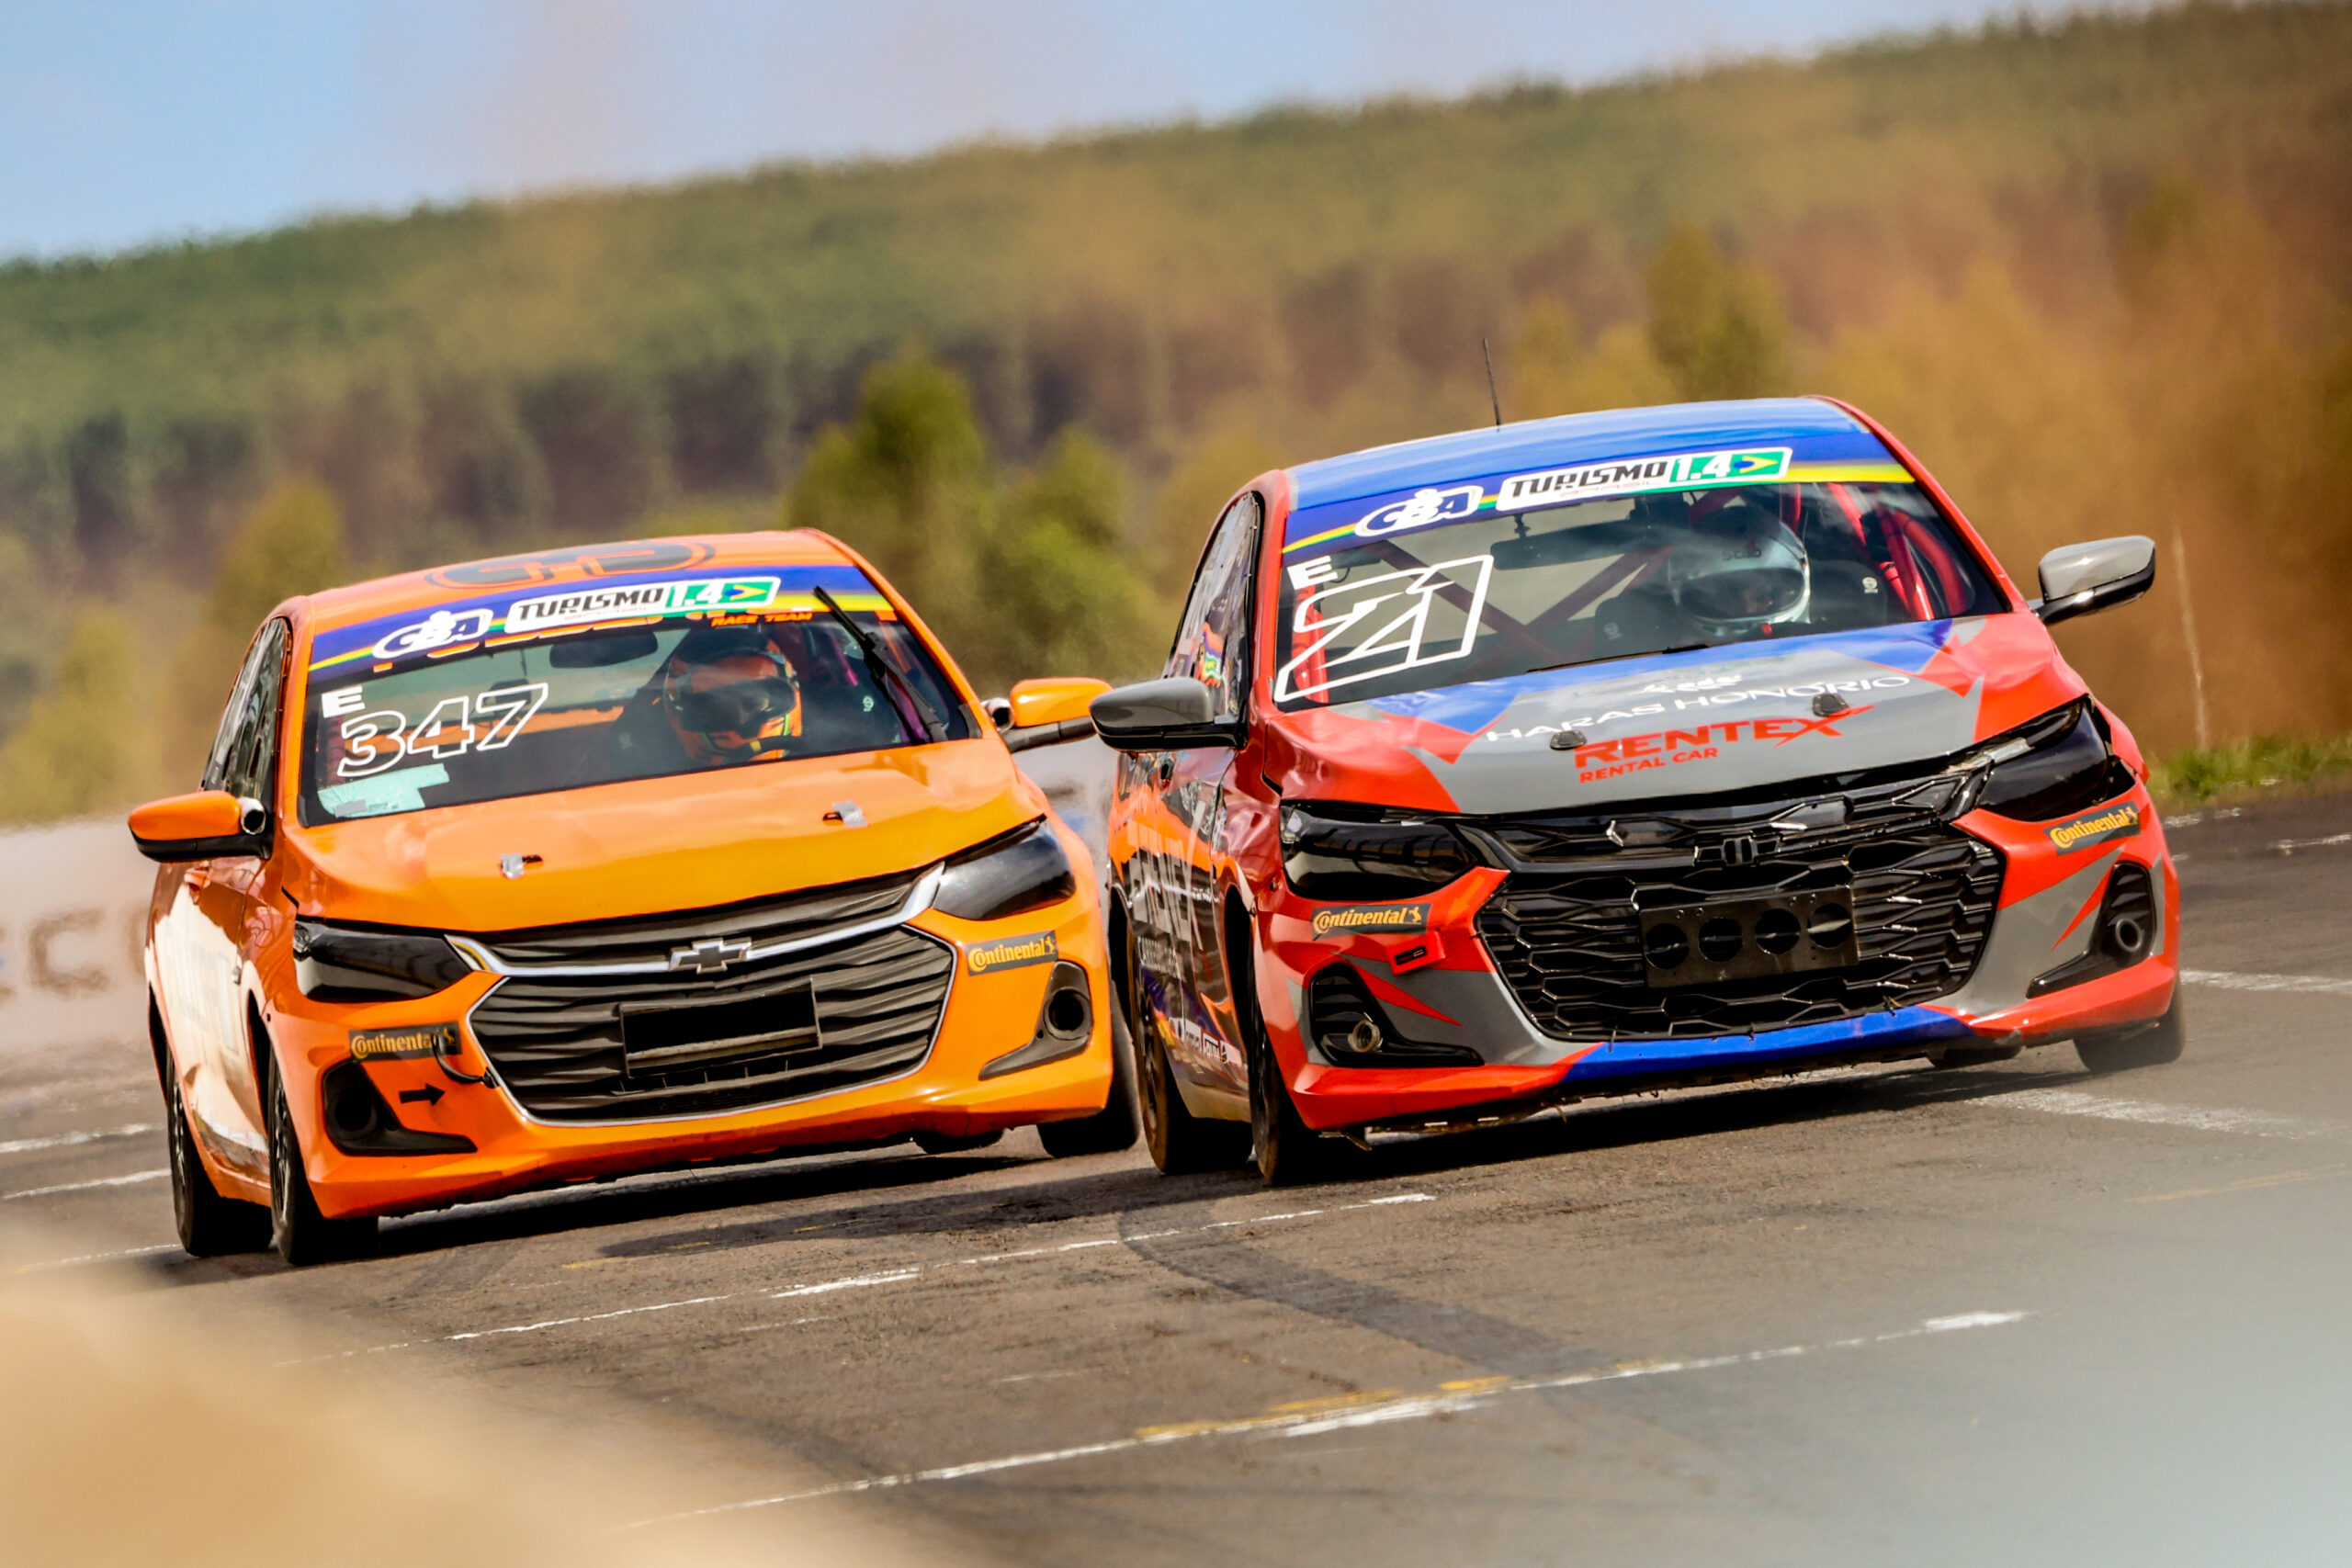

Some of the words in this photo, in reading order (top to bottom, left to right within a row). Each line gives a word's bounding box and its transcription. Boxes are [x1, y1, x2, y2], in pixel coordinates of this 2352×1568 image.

[1511, 461, 1668, 498] TURISMO
[1676, 454, 1732, 481] 1.4
[1355, 489, 1483, 536] CBA
[1287, 555, 1338, 590] E
[518, 588, 663, 619] TURISMO
[666, 581, 724, 607] 1.4
[375, 610, 493, 659] CBA
[711, 615, 759, 626] RACE
[764, 613, 813, 622] TEAM
[322, 685, 366, 718] E
[337, 682, 548, 777] 347
[1574, 705, 1877, 768] RENTEX
[1579, 757, 1667, 784] RENTAL
[1672, 748, 1719, 763] CAR
[2050, 808, 2128, 849] Continental
[1313, 908, 1408, 934] Continental
[967, 937, 1046, 972] Continental
